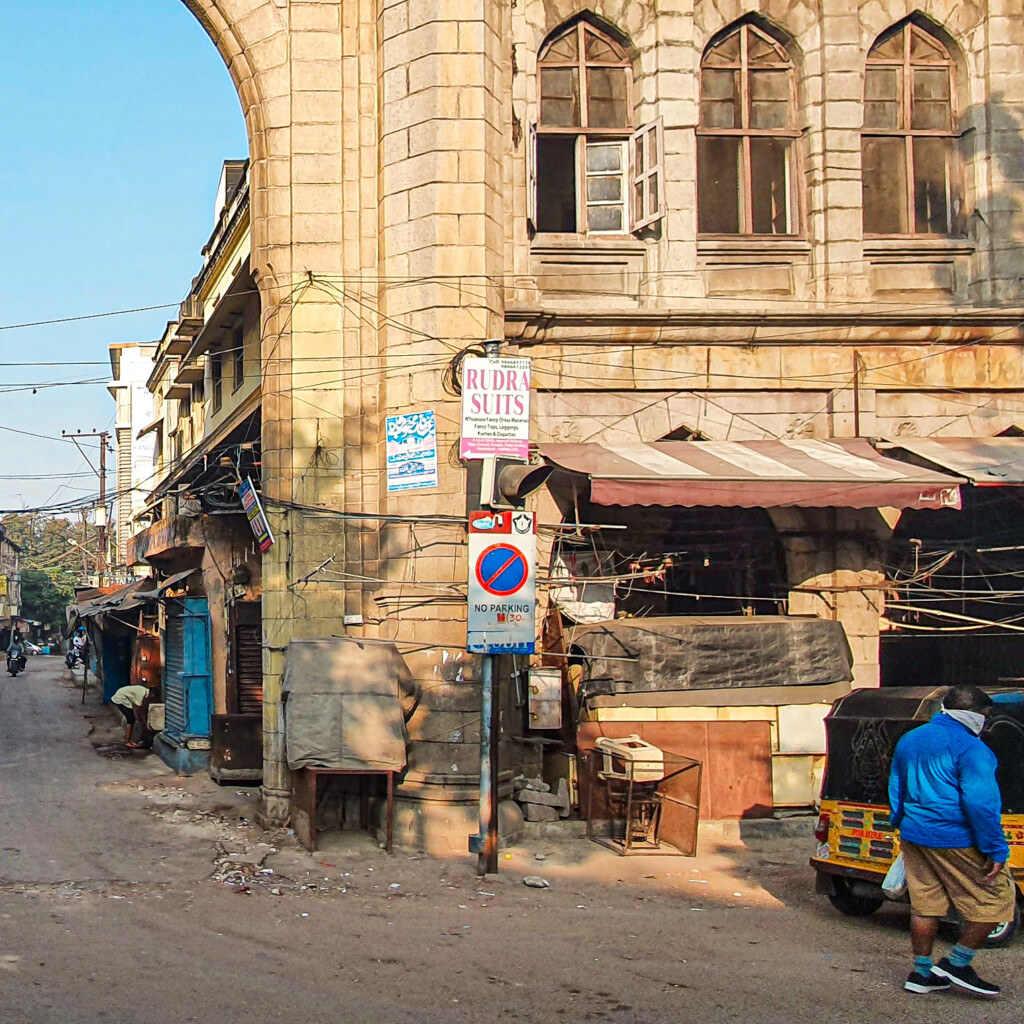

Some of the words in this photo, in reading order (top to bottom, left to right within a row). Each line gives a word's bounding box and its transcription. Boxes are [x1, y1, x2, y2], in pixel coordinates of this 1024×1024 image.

[466, 369, 530, 392] RUDRA
[470, 393, 524, 416] SUITS
[474, 604, 488, 613] NO
[490, 604, 530, 614] PARKING
